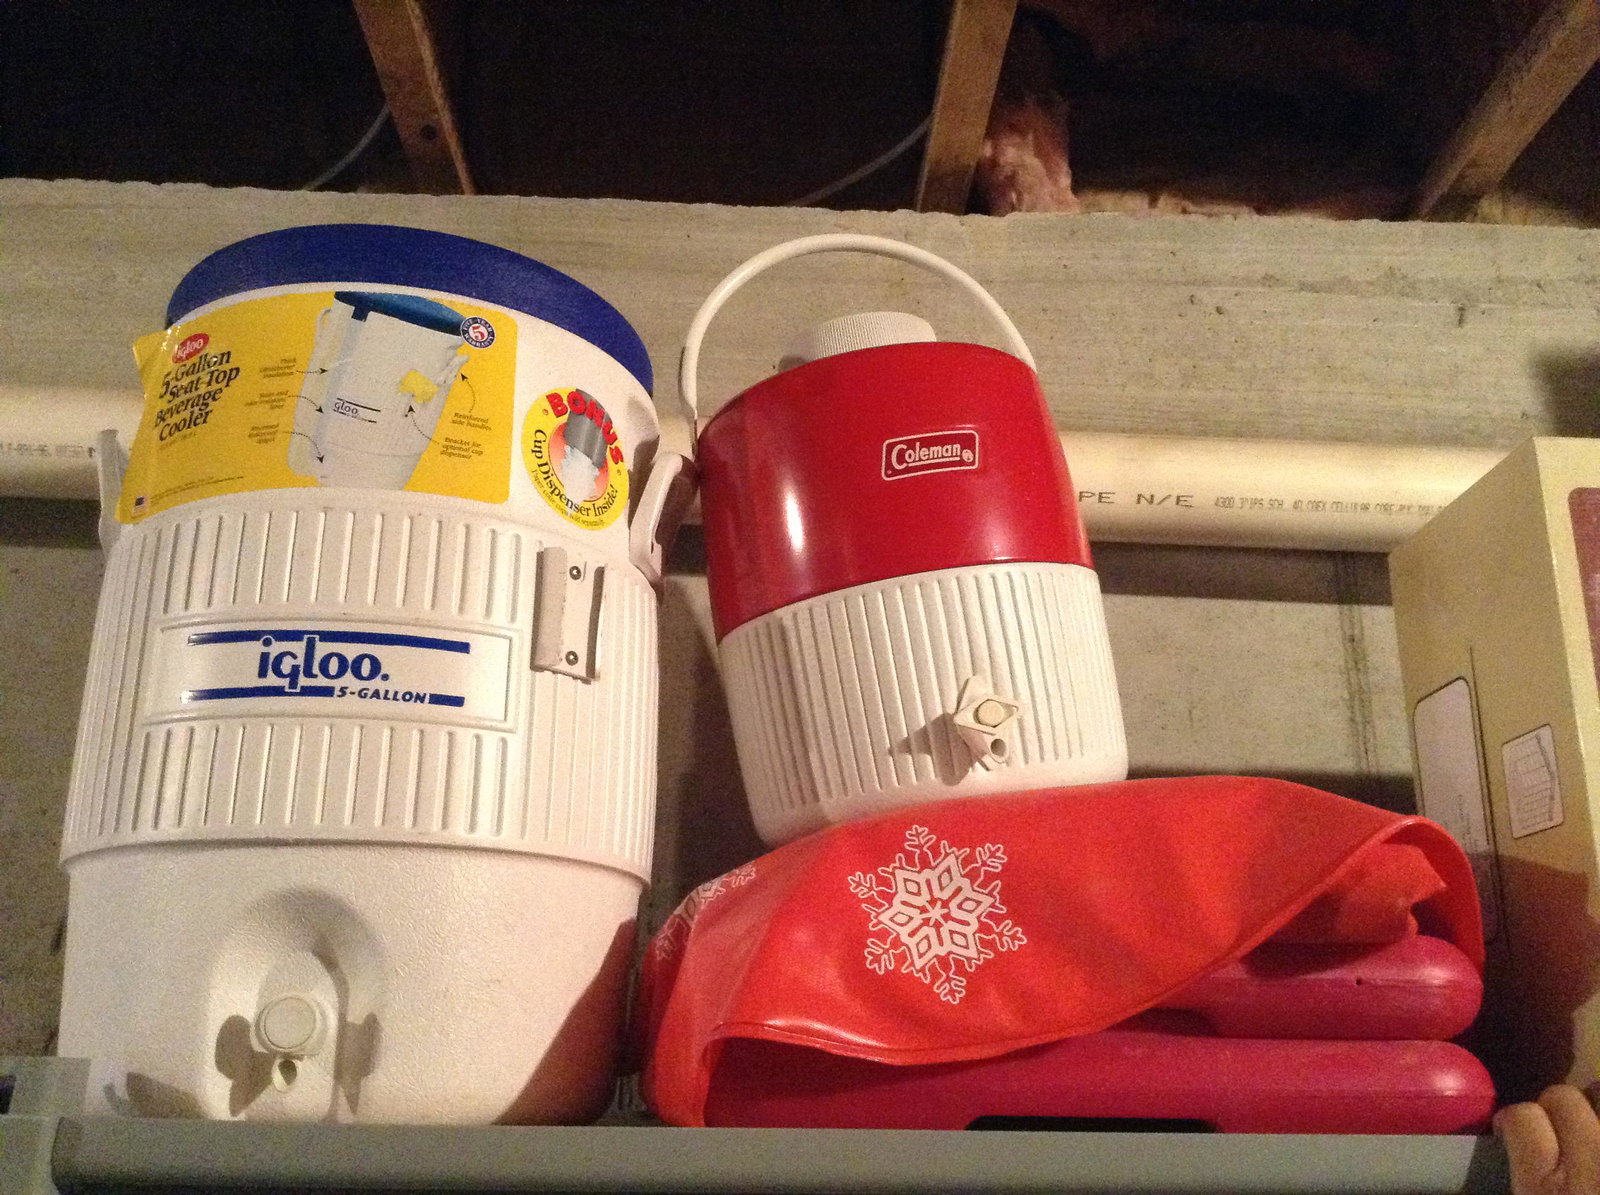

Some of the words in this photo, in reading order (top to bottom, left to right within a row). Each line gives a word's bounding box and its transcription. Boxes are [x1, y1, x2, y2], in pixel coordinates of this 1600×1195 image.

[472, 325, 486, 341] 5
[154, 387, 223, 428] Beverage
[158, 409, 213, 441] Cooler
[545, 390, 624, 465] BONUS
[531, 428, 548, 460] Cup
[891, 441, 961, 470] Coleman
[537, 461, 592, 516] Dispenser
[592, 483, 619, 517] Inside!
[1135, 493, 1194, 508] N/E
[336, 686, 427, 705] 5-GALLON
